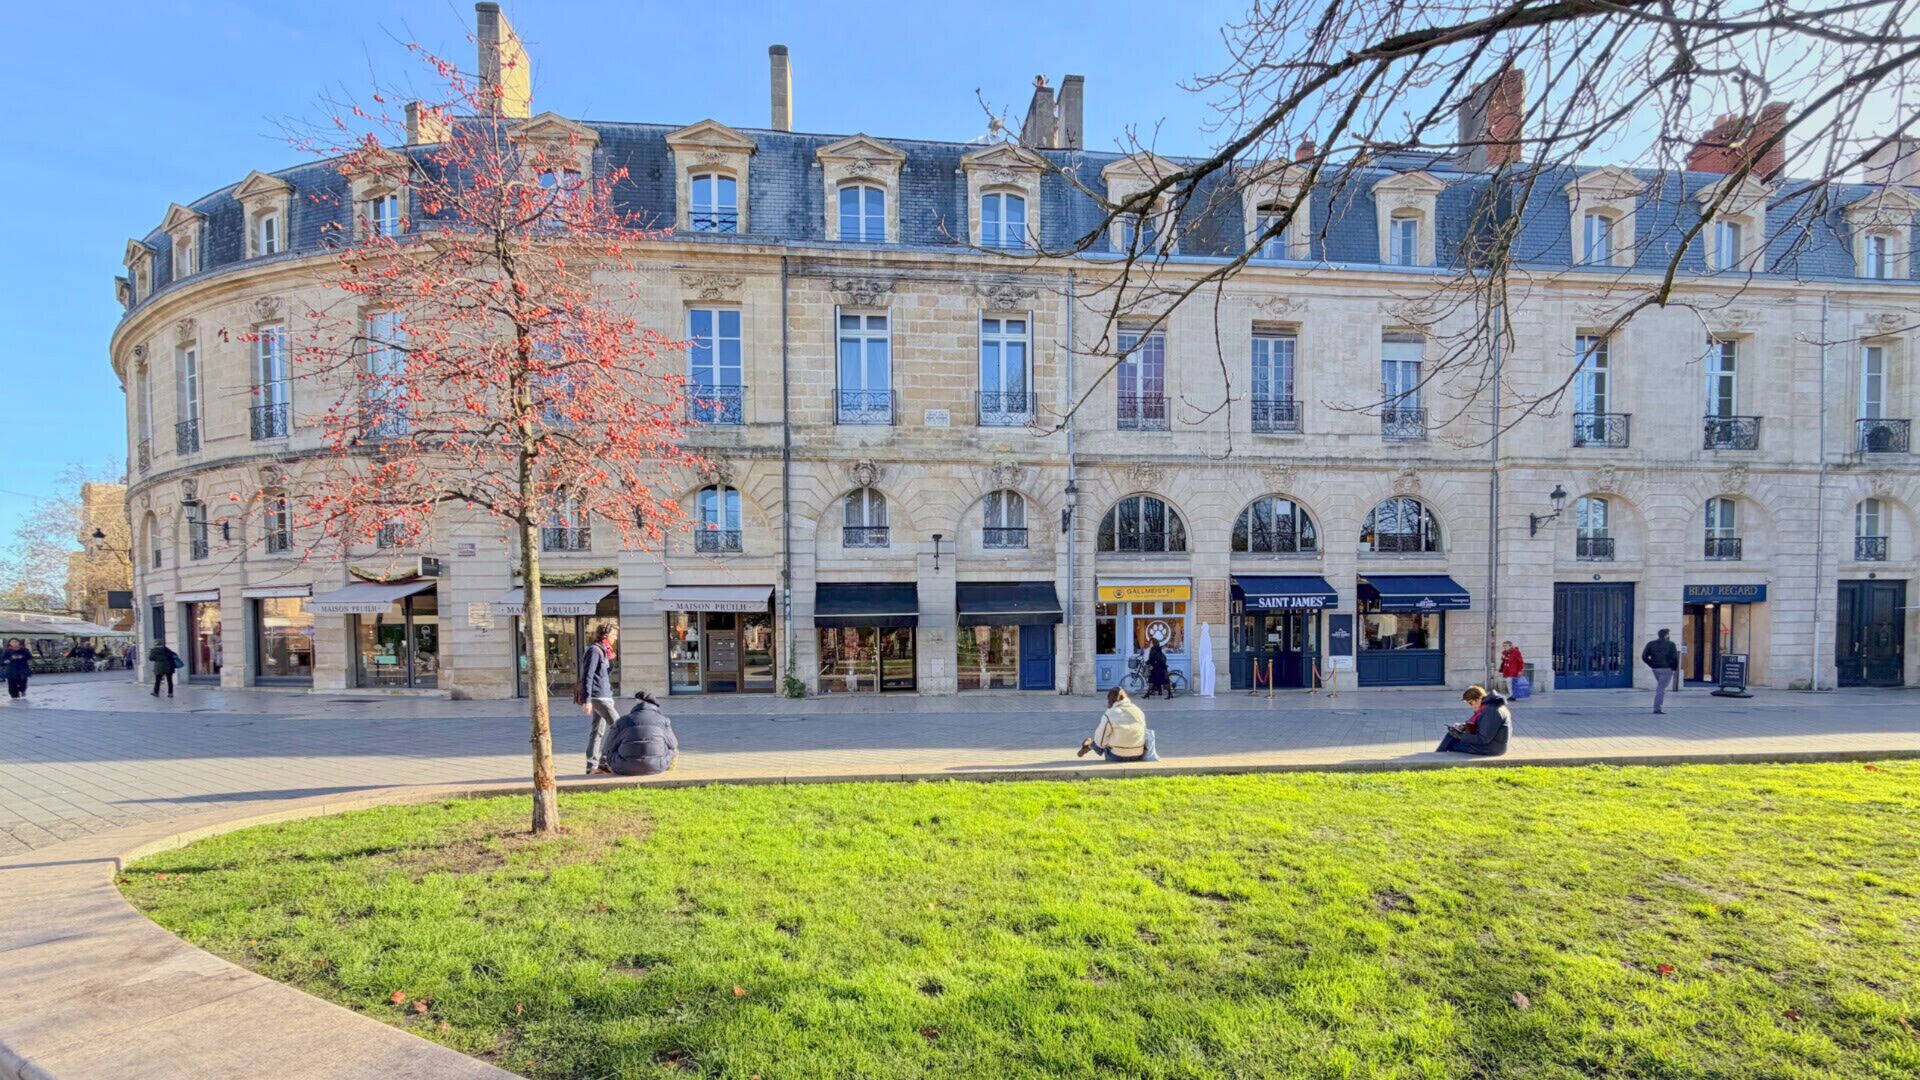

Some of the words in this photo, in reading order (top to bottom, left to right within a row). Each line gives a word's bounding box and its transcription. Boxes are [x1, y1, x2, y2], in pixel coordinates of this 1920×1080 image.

[1688, 586, 1714, 596] BEAU
[1718, 586, 1758, 595] REGARD
[1258, 597, 1289, 607] SAINT
[1290, 596, 1324, 607] JAMES
